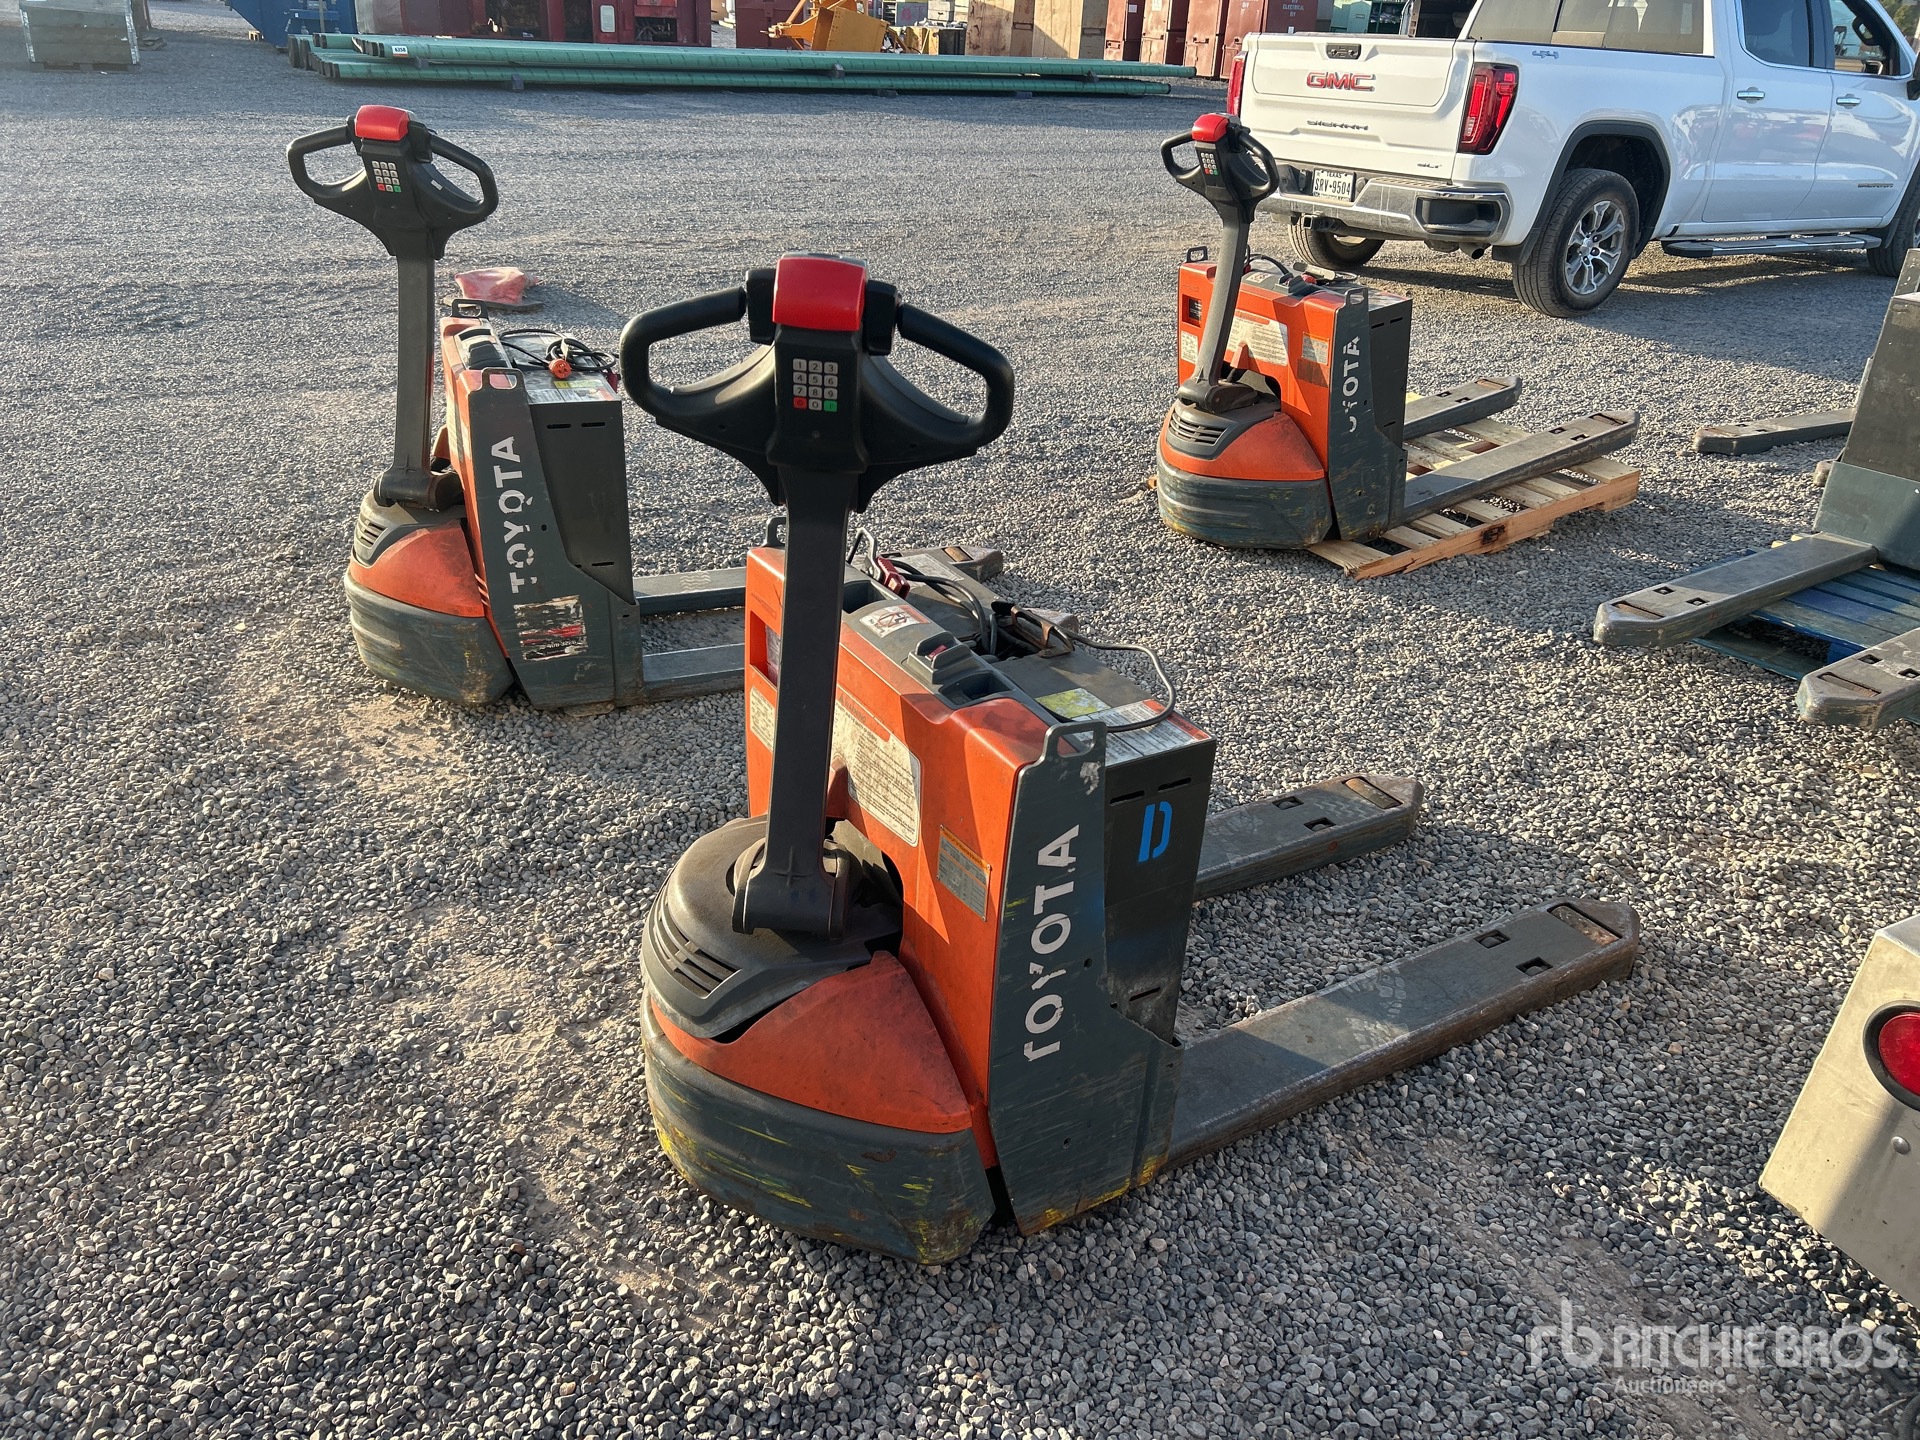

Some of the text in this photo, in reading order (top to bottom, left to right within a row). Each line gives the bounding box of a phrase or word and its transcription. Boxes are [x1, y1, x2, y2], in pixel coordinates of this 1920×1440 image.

[1306, 72, 1376, 92] GMC
[812, 388, 818, 396] 8
[491, 436, 538, 594] TOYOTA
[1138, 801, 1173, 862] D
